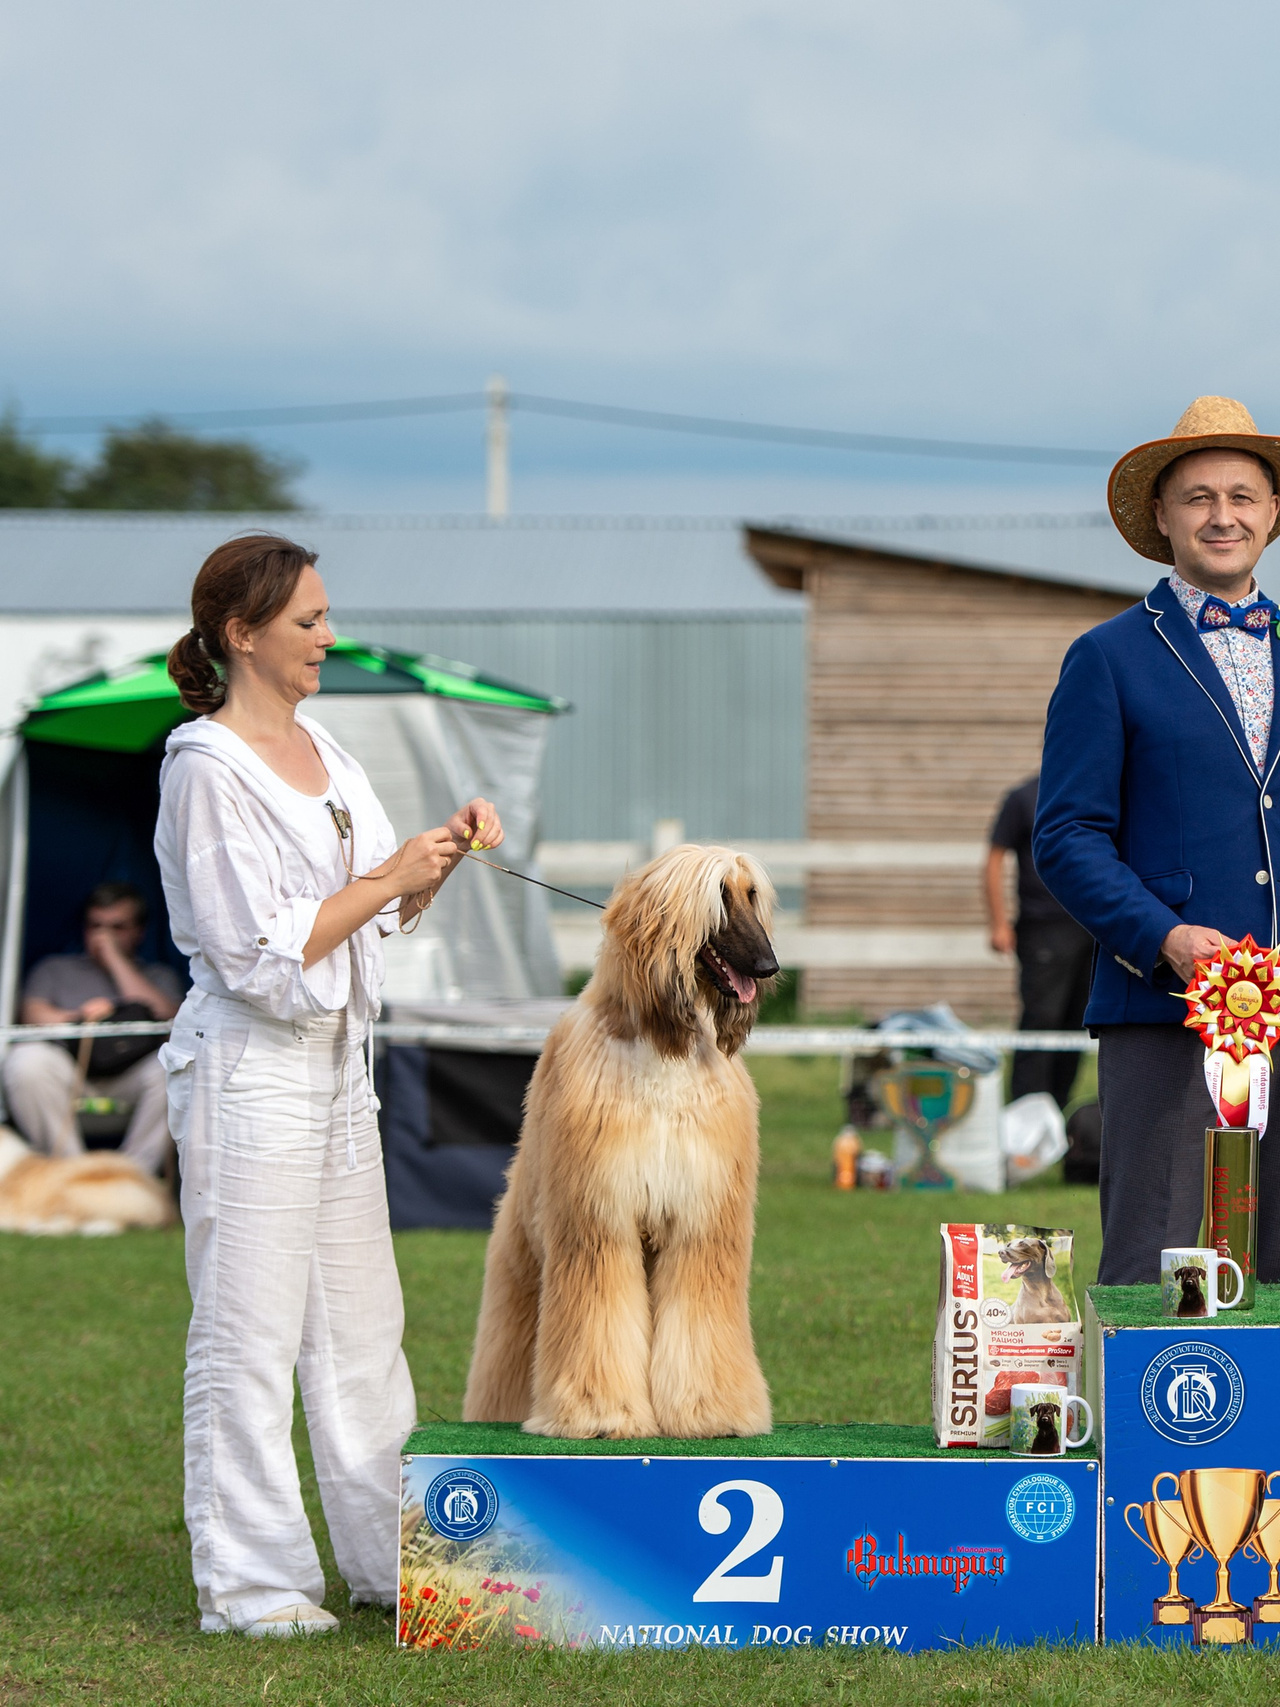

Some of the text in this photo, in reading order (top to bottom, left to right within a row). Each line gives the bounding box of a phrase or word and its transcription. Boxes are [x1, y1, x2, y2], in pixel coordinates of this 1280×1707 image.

[956, 1271, 975, 1283] ADULT
[985, 1308, 1007, 1318] 40%
[990, 1329, 1025, 1337] МЯСНОЙ
[950, 1309, 978, 1427] SIRIUS
[1144, 1344, 1241, 1424] БЕЛОРУССКОЕ КИНОЛОГИЧЕСКОЕ ОБЪЕДИНЕНИЕ
[1008, 1475, 1073, 1538] FEDERATION CYNOLOGIQUE INTERNATIONALE
[1026, 1502, 1054, 1513] FCI
[692, 1479, 785, 1603] 2
[847, 1523, 1006, 1594] Виктория
[598, 1624, 909, 1646] NATIONAL DOG SHOW
